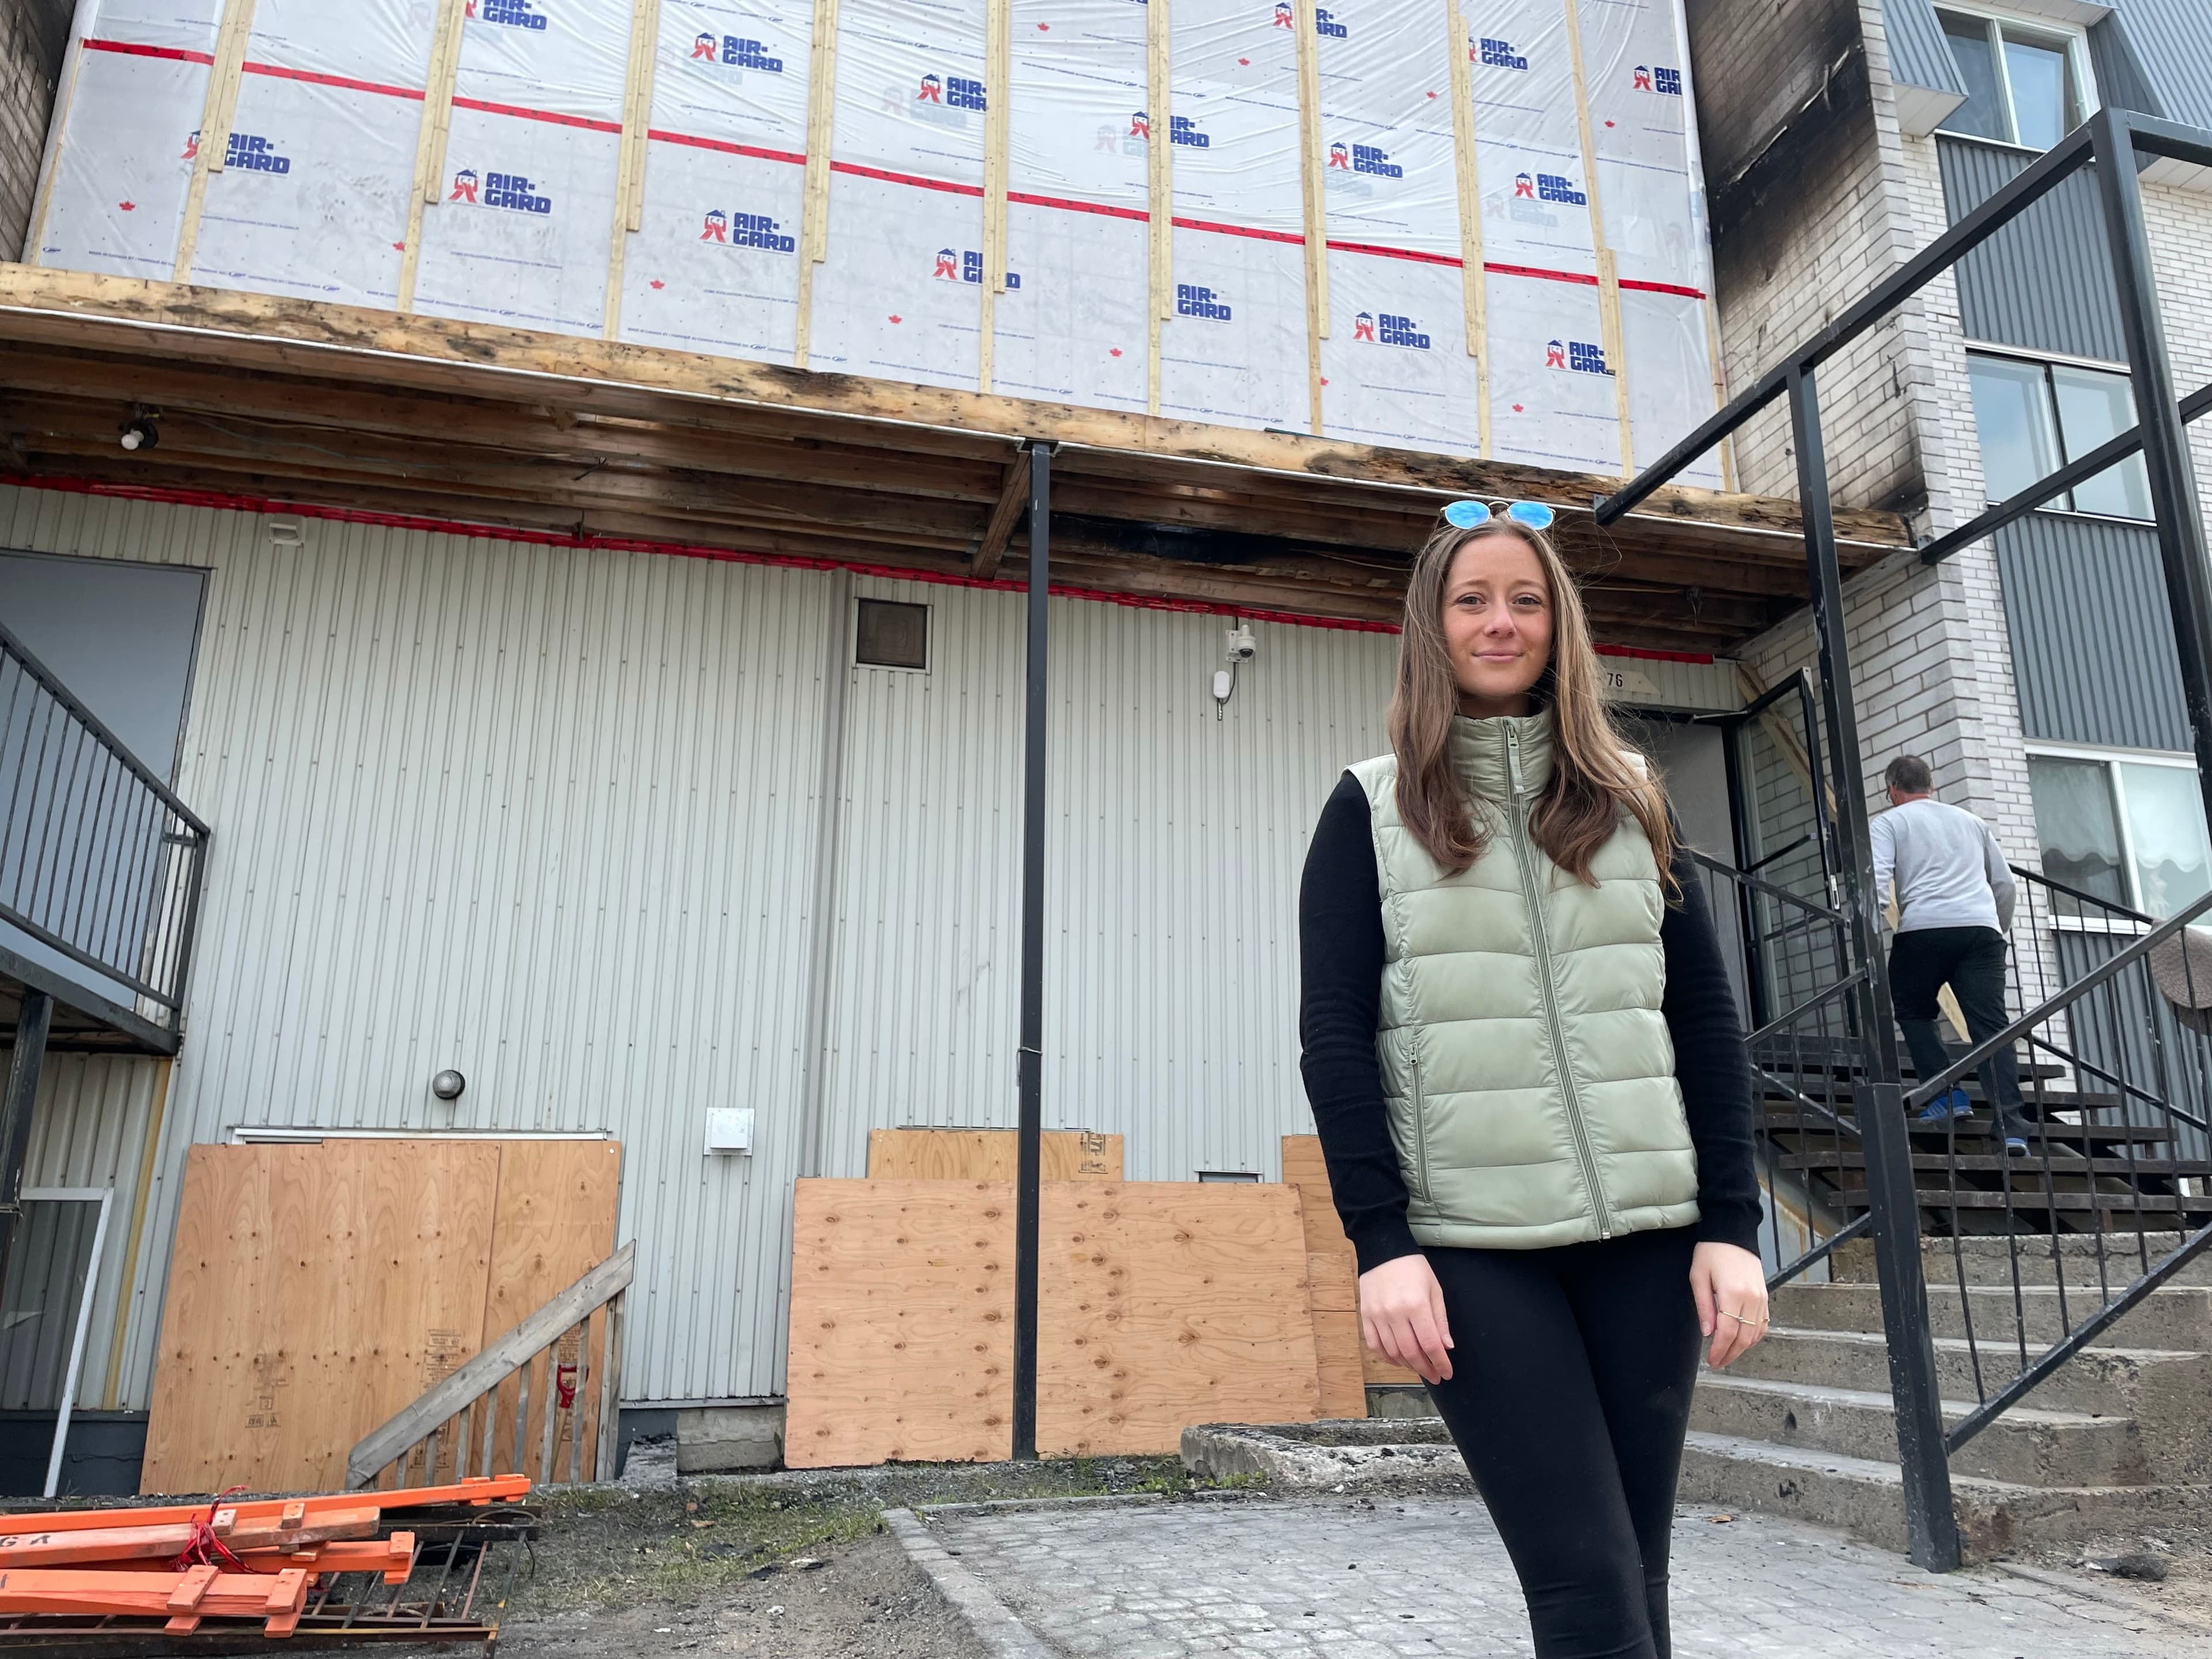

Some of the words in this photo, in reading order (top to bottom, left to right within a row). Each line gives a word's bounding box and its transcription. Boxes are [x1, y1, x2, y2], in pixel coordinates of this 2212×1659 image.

[483, 7, 547, 29] GARD
[1316, 8, 1334, 21] R-
[724, 35, 768, 54] AIR-
[1480, 38, 1514, 54] AIR-
[723, 49, 782, 72] GARD
[1482, 51, 1528, 70] GARD
[1654, 67, 1680, 82] AIR
[1656, 80, 1682, 95] GA
[948, 90, 986, 112] GAR
[1171, 116, 1195, 130] IR-
[229, 133, 274, 152] AIR-
[1171, 130, 1209, 147] ARD
[225, 150, 290, 173] GARD
[1353, 144, 1388, 162] AIR-
[1354, 158, 1403, 178] GARD
[486, 172, 535, 194] AIR-
[1537, 173, 1573, 190] AIR-
[484, 190, 551, 214] GARD
[1539, 187, 1586, 206] GARD
[734, 213, 780, 232] AIR-
[733, 229, 795, 253] GARD
[964, 251, 983, 268] AI
[964, 266, 1020, 289] GD
[1177, 284, 1218, 303] AIR-
[1177, 300, 1232, 321] GARD
[1380, 314, 1416, 332] AIR-
[1381, 329, 1430, 349] GARD
[1569, 342, 1604, 358] AIR-
[1571, 356, 1615, 376] GAR
[1607, 673, 1623, 687] 76
